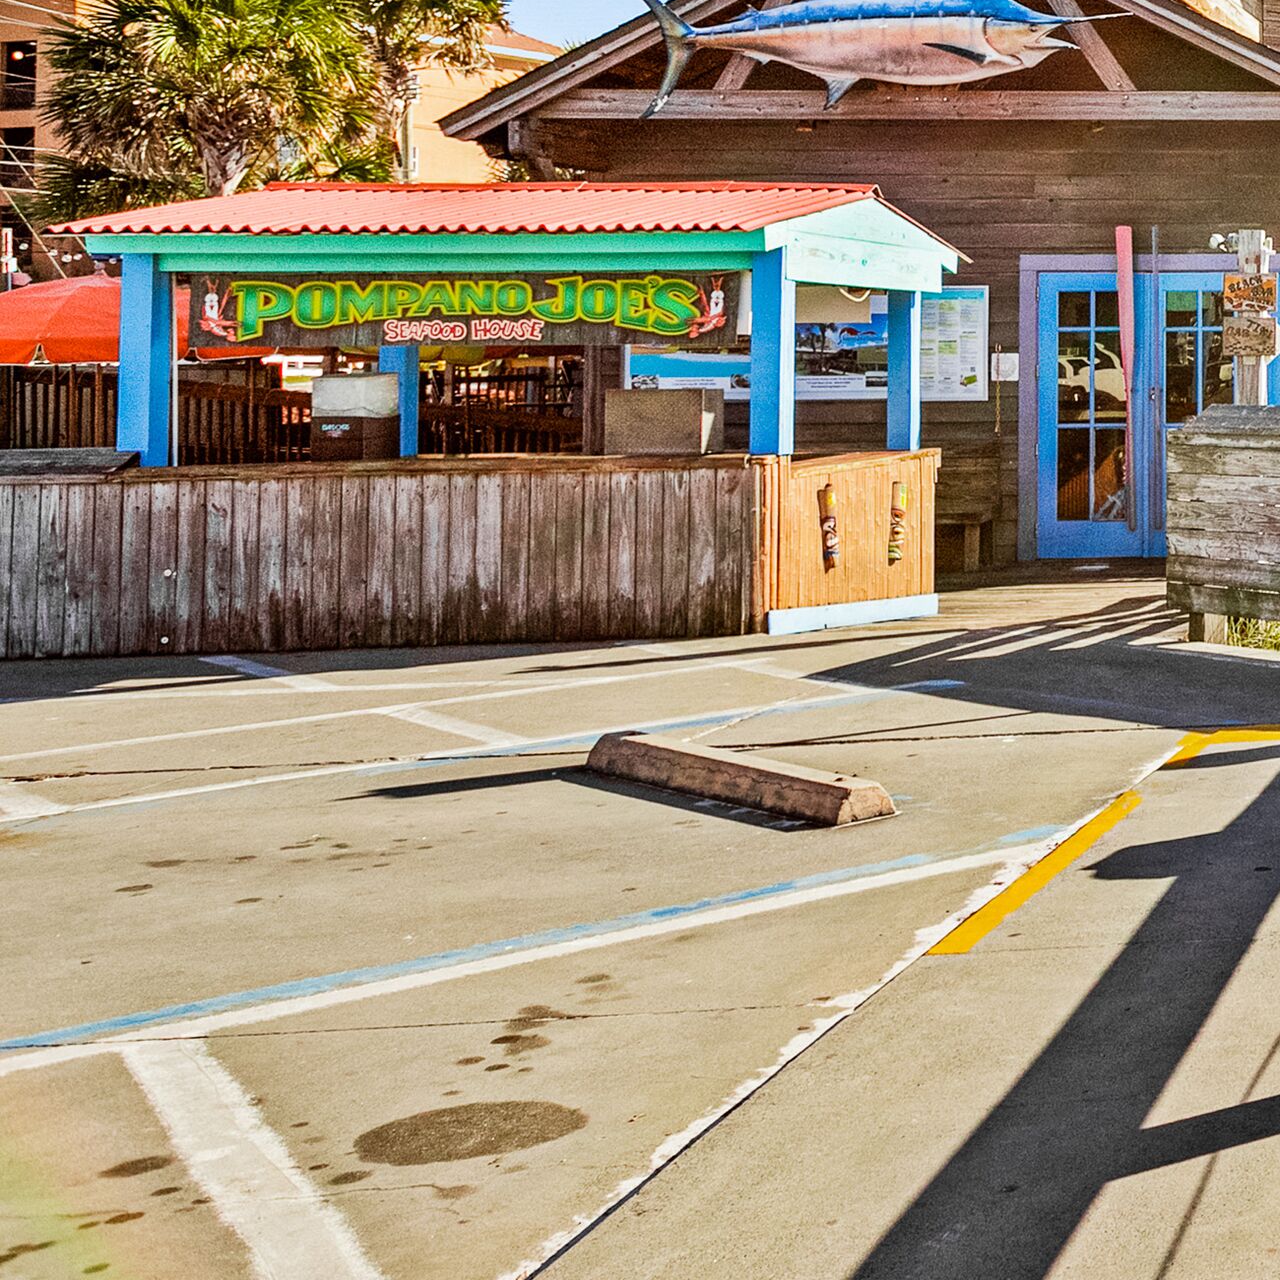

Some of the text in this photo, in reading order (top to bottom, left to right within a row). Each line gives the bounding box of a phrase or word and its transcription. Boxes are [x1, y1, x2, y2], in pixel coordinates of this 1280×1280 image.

[231, 275, 702, 343] POMPANO JOE'S
[383, 318, 544, 342] SEAFOOD HOUSE
